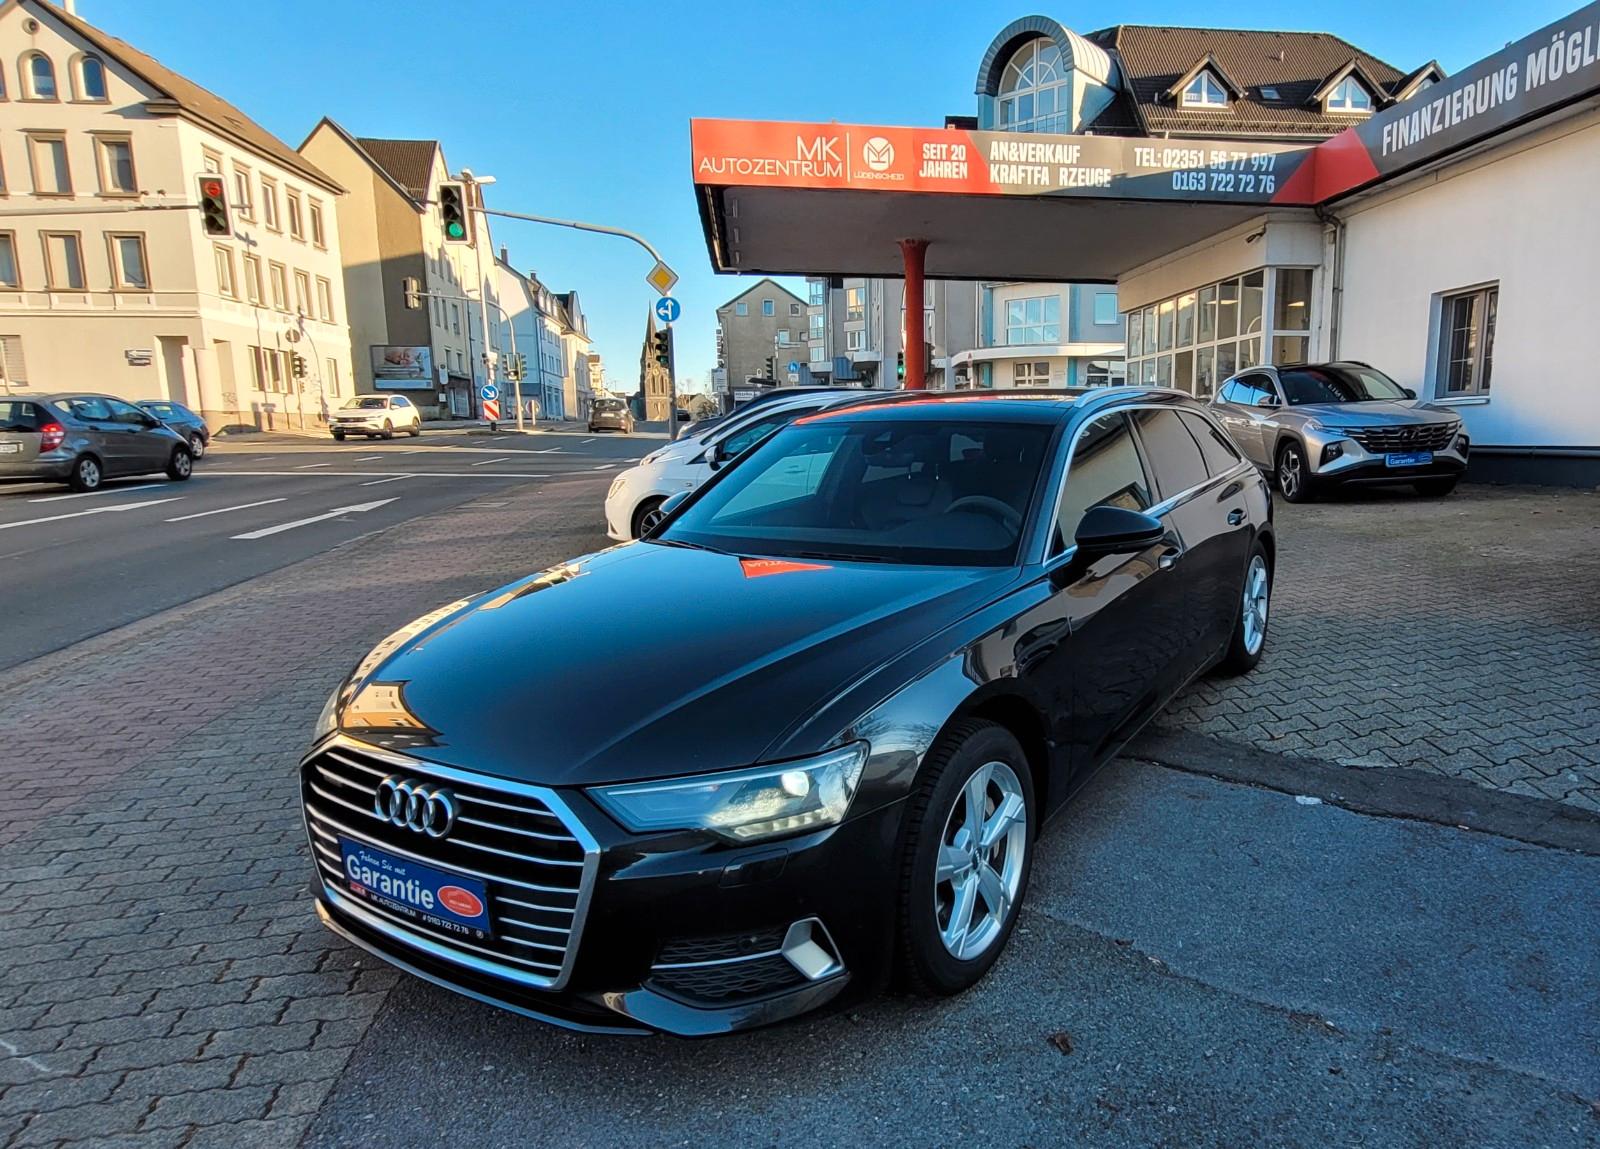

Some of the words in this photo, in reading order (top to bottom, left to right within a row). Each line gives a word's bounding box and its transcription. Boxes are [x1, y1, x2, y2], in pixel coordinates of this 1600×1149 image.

[1382, 62, 1518, 156] FINANZIERUNG
[798, 136, 840, 161] MK
[922, 144, 948, 160] SEIT
[951, 145, 966, 160] 20
[989, 141, 1081, 164] AN&VERKAUF
[699, 158, 842, 177] AUTOZENTRUM
[919, 160, 968, 179] JAHREN
[1210, 151, 1226, 170] 56
[1230, 152, 1248, 171] 77
[1251, 152, 1277, 172] 997
[1172, 172, 1206, 191] 0163
[1210, 174, 1233, 193] 722
[1237, 175, 1254, 193] 72
[1258, 176, 1275, 194] 76
[346, 854, 434, 909] Garantie
